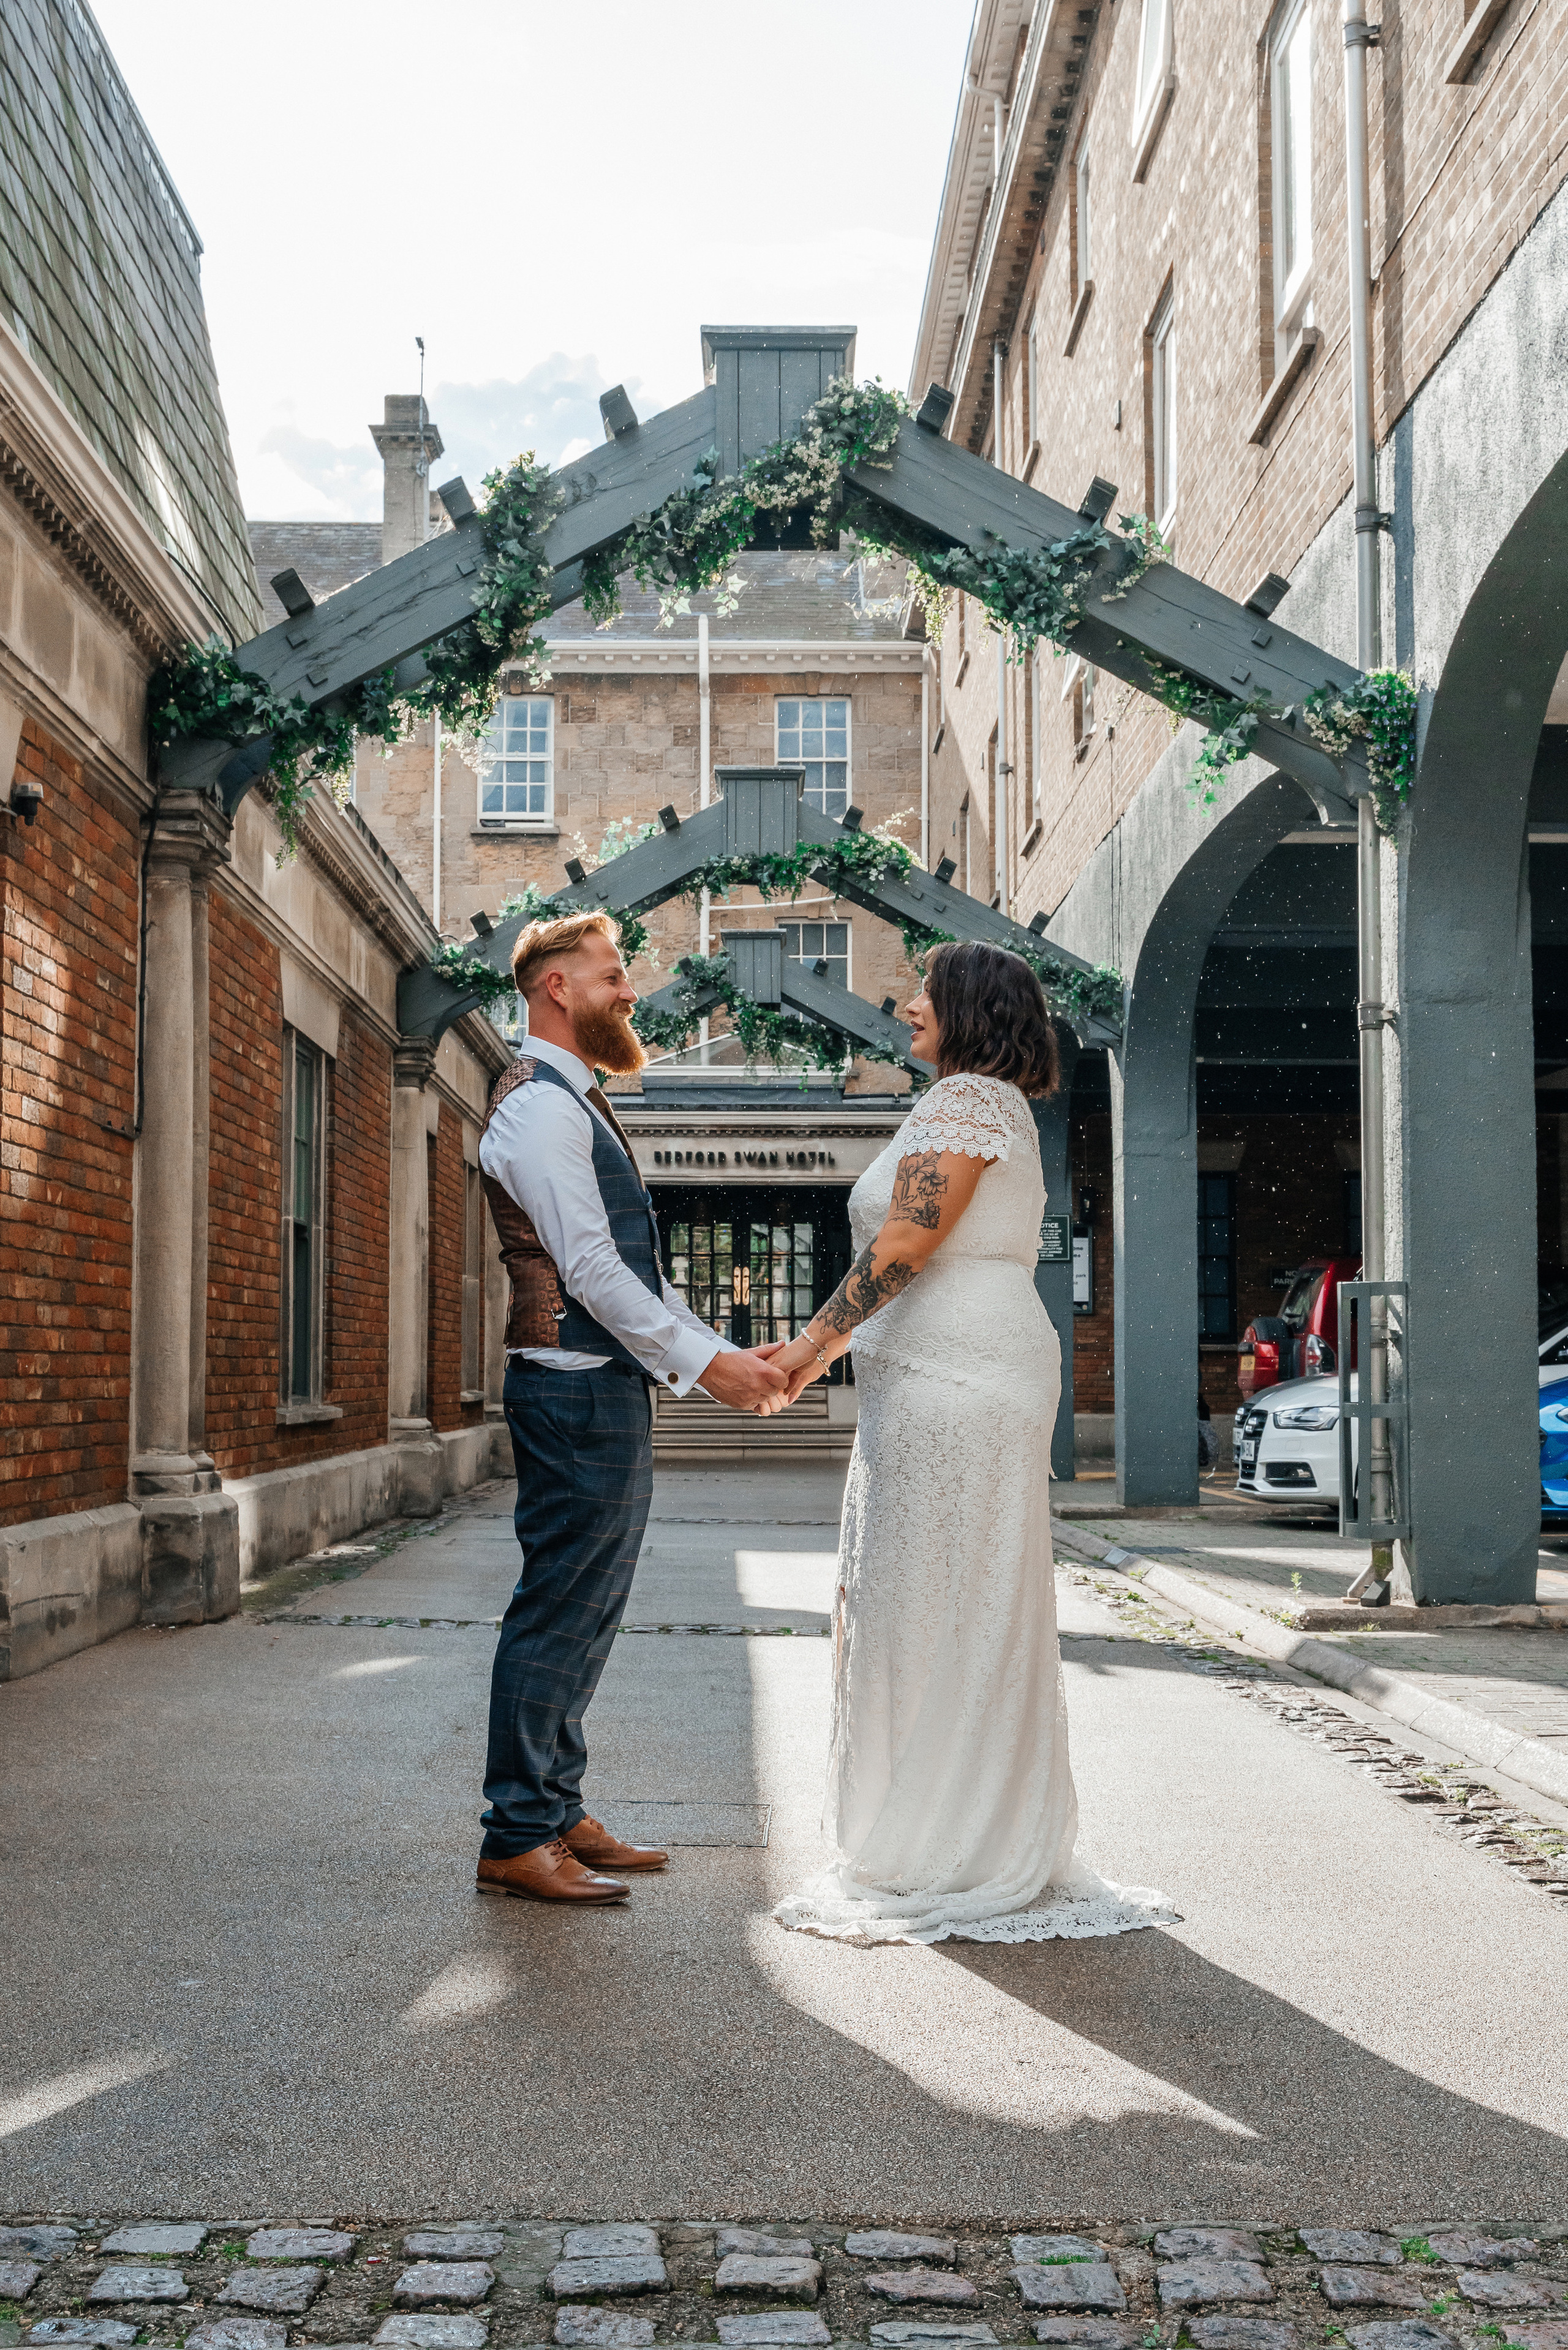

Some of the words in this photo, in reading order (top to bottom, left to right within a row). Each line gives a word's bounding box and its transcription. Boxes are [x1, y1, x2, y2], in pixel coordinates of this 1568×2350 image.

[654, 1151, 725, 1164] BEDFORD
[735, 1151, 778, 1164] SWAN
[786, 1151, 835, 1165] HOTEL
